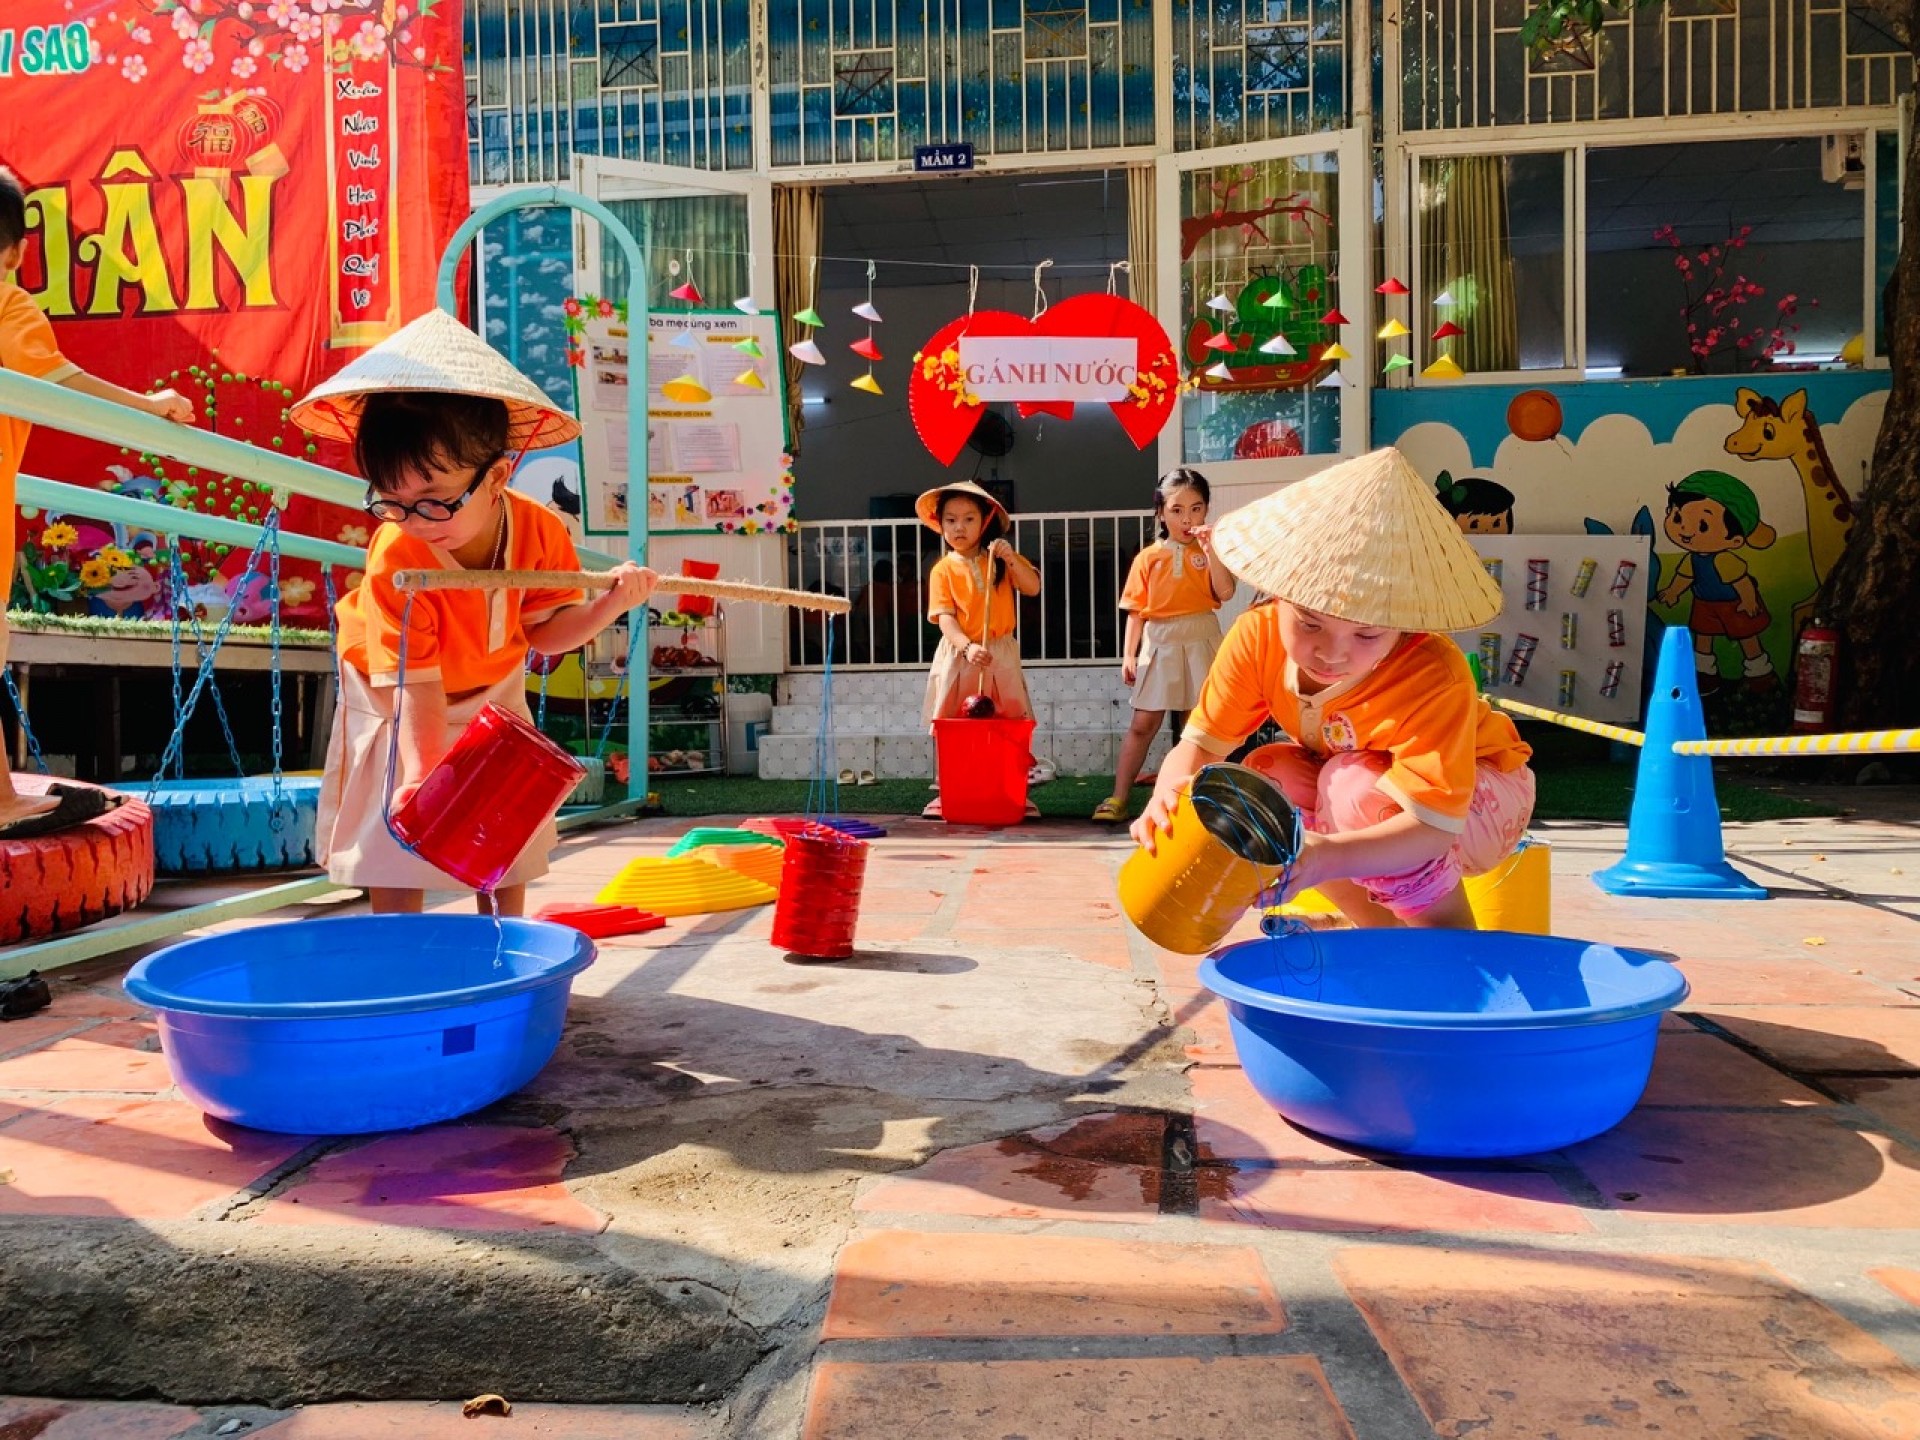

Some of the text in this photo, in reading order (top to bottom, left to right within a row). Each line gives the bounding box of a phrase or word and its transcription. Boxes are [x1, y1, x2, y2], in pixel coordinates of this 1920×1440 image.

[20, 22, 90, 74] SAO
[349, 147, 378, 168] Vinh
[957, 152, 967, 165] 2
[348, 187, 375, 203] Hoa
[649, 318, 664, 328] ba
[713, 320, 738, 329] xem
[965, 357, 1135, 385] GÁNH NƯỚC
